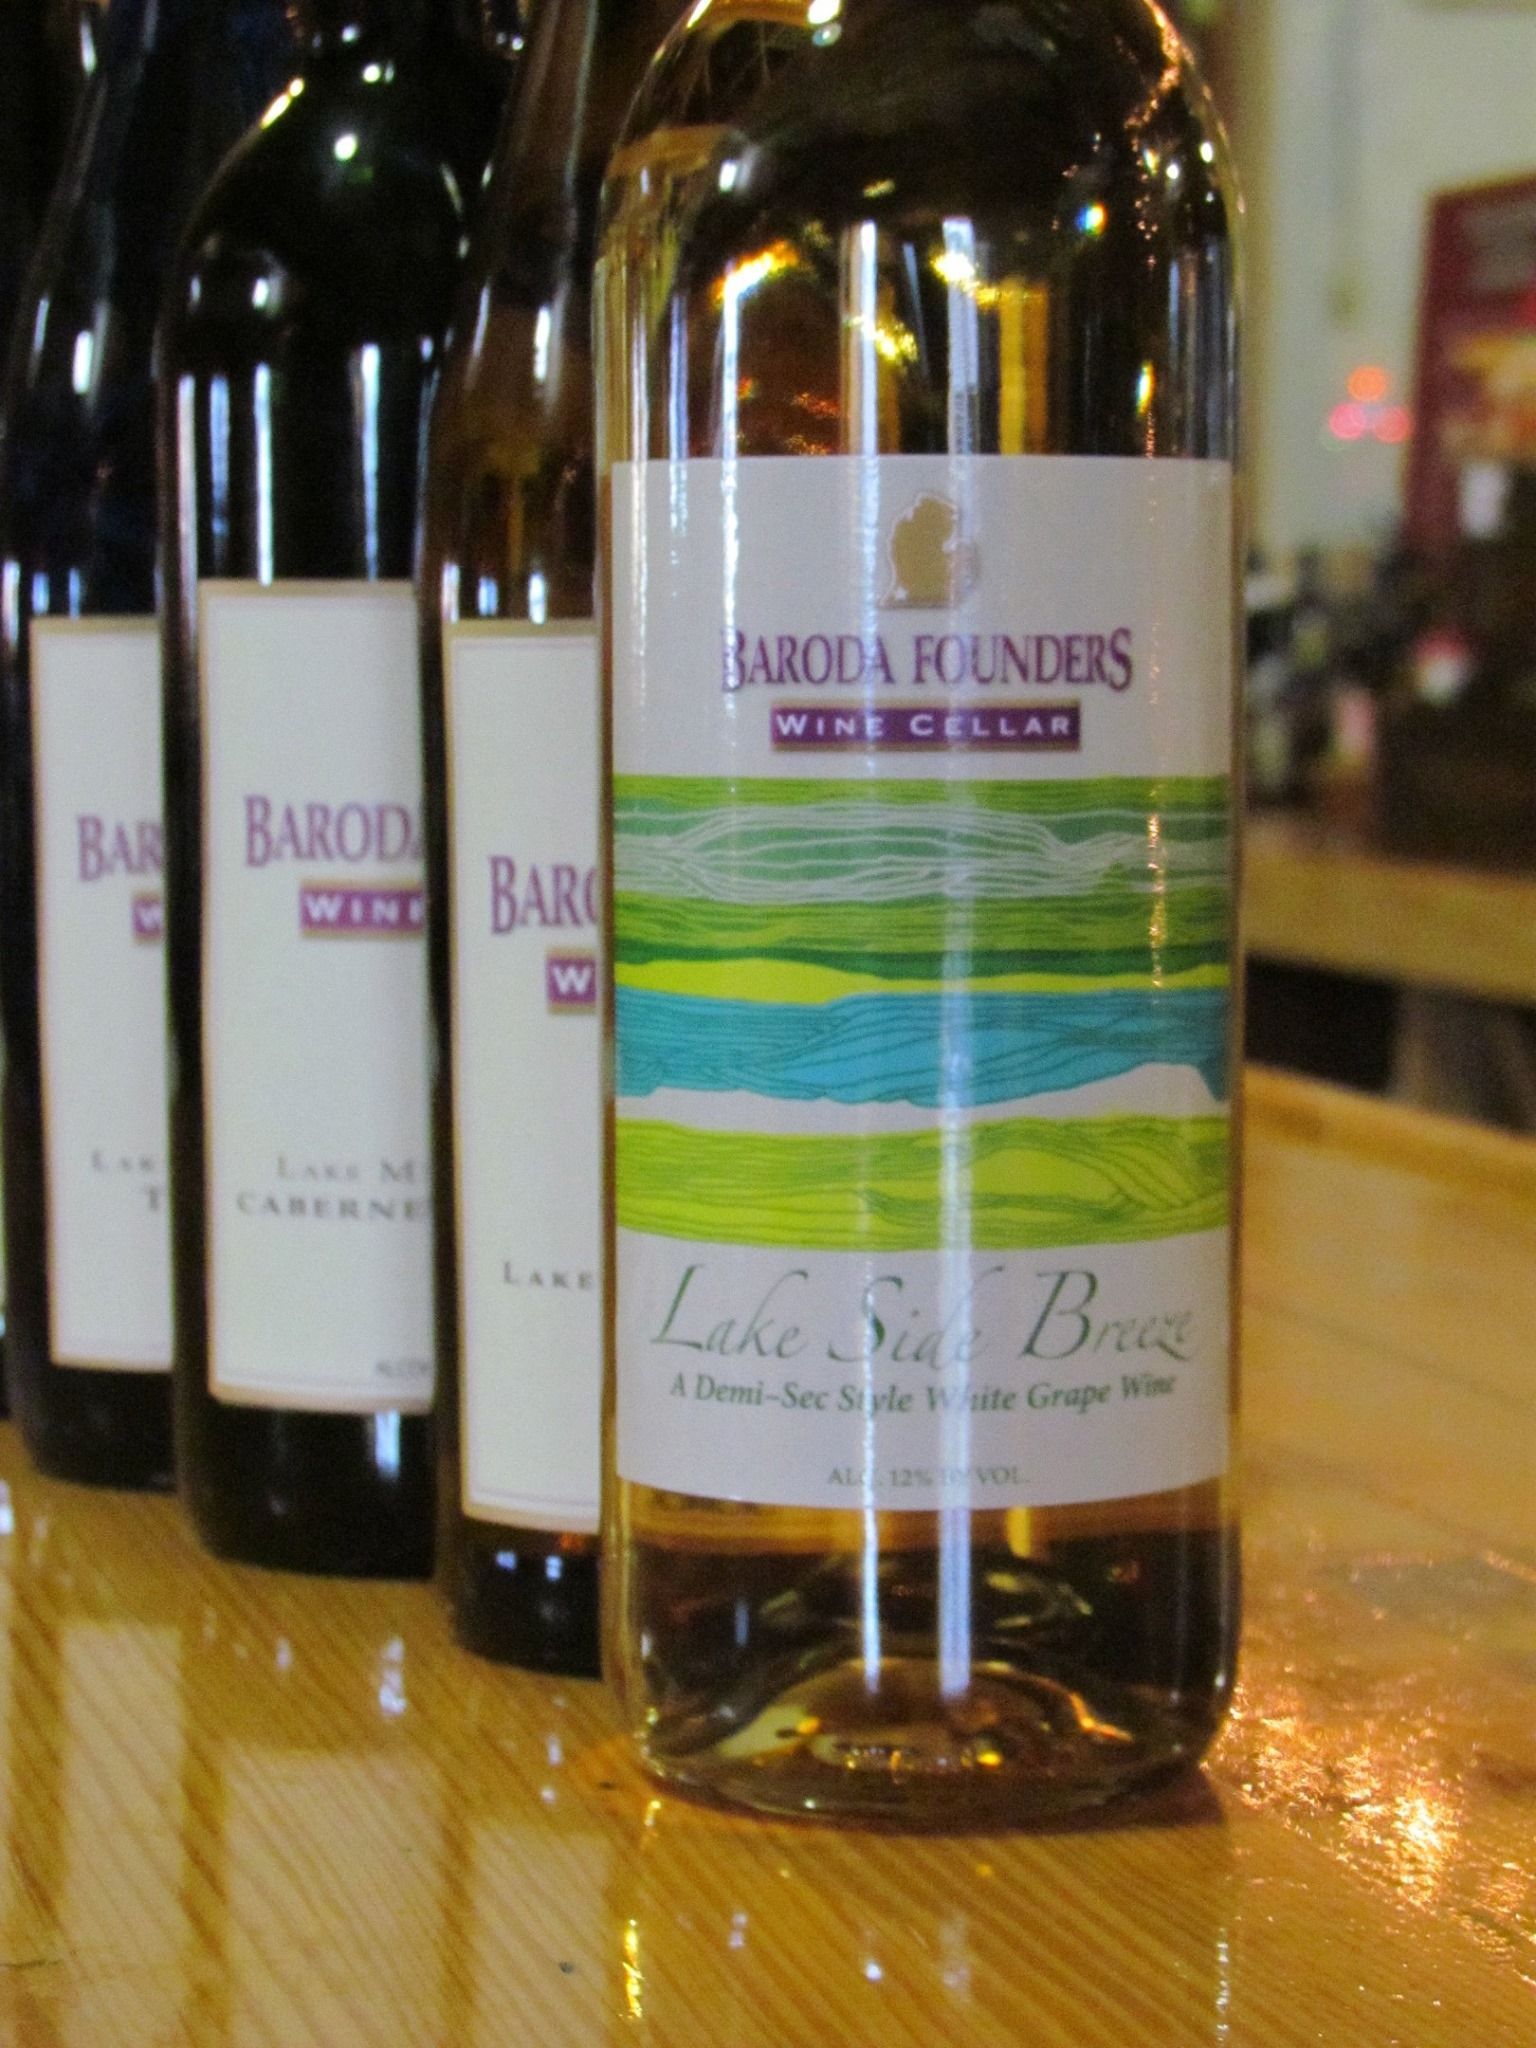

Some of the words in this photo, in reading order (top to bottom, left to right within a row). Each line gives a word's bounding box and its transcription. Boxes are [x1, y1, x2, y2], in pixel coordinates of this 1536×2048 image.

[721, 629, 895, 692] BARODA
[913, 627, 1133, 692] FOUNDERS
[776, 713, 884, 738] WINE
[909, 713, 1072, 738] CELLAR
[650, 1263, 809, 1360] Lake
[1018, 1269, 1196, 1363] Breeze
[670, 1371, 687, 1399] A
[696, 1373, 829, 1411] Demi-Sec
[1027, 1381, 1112, 1414] Grape
[1120, 1373, 1177, 1399] Wine
